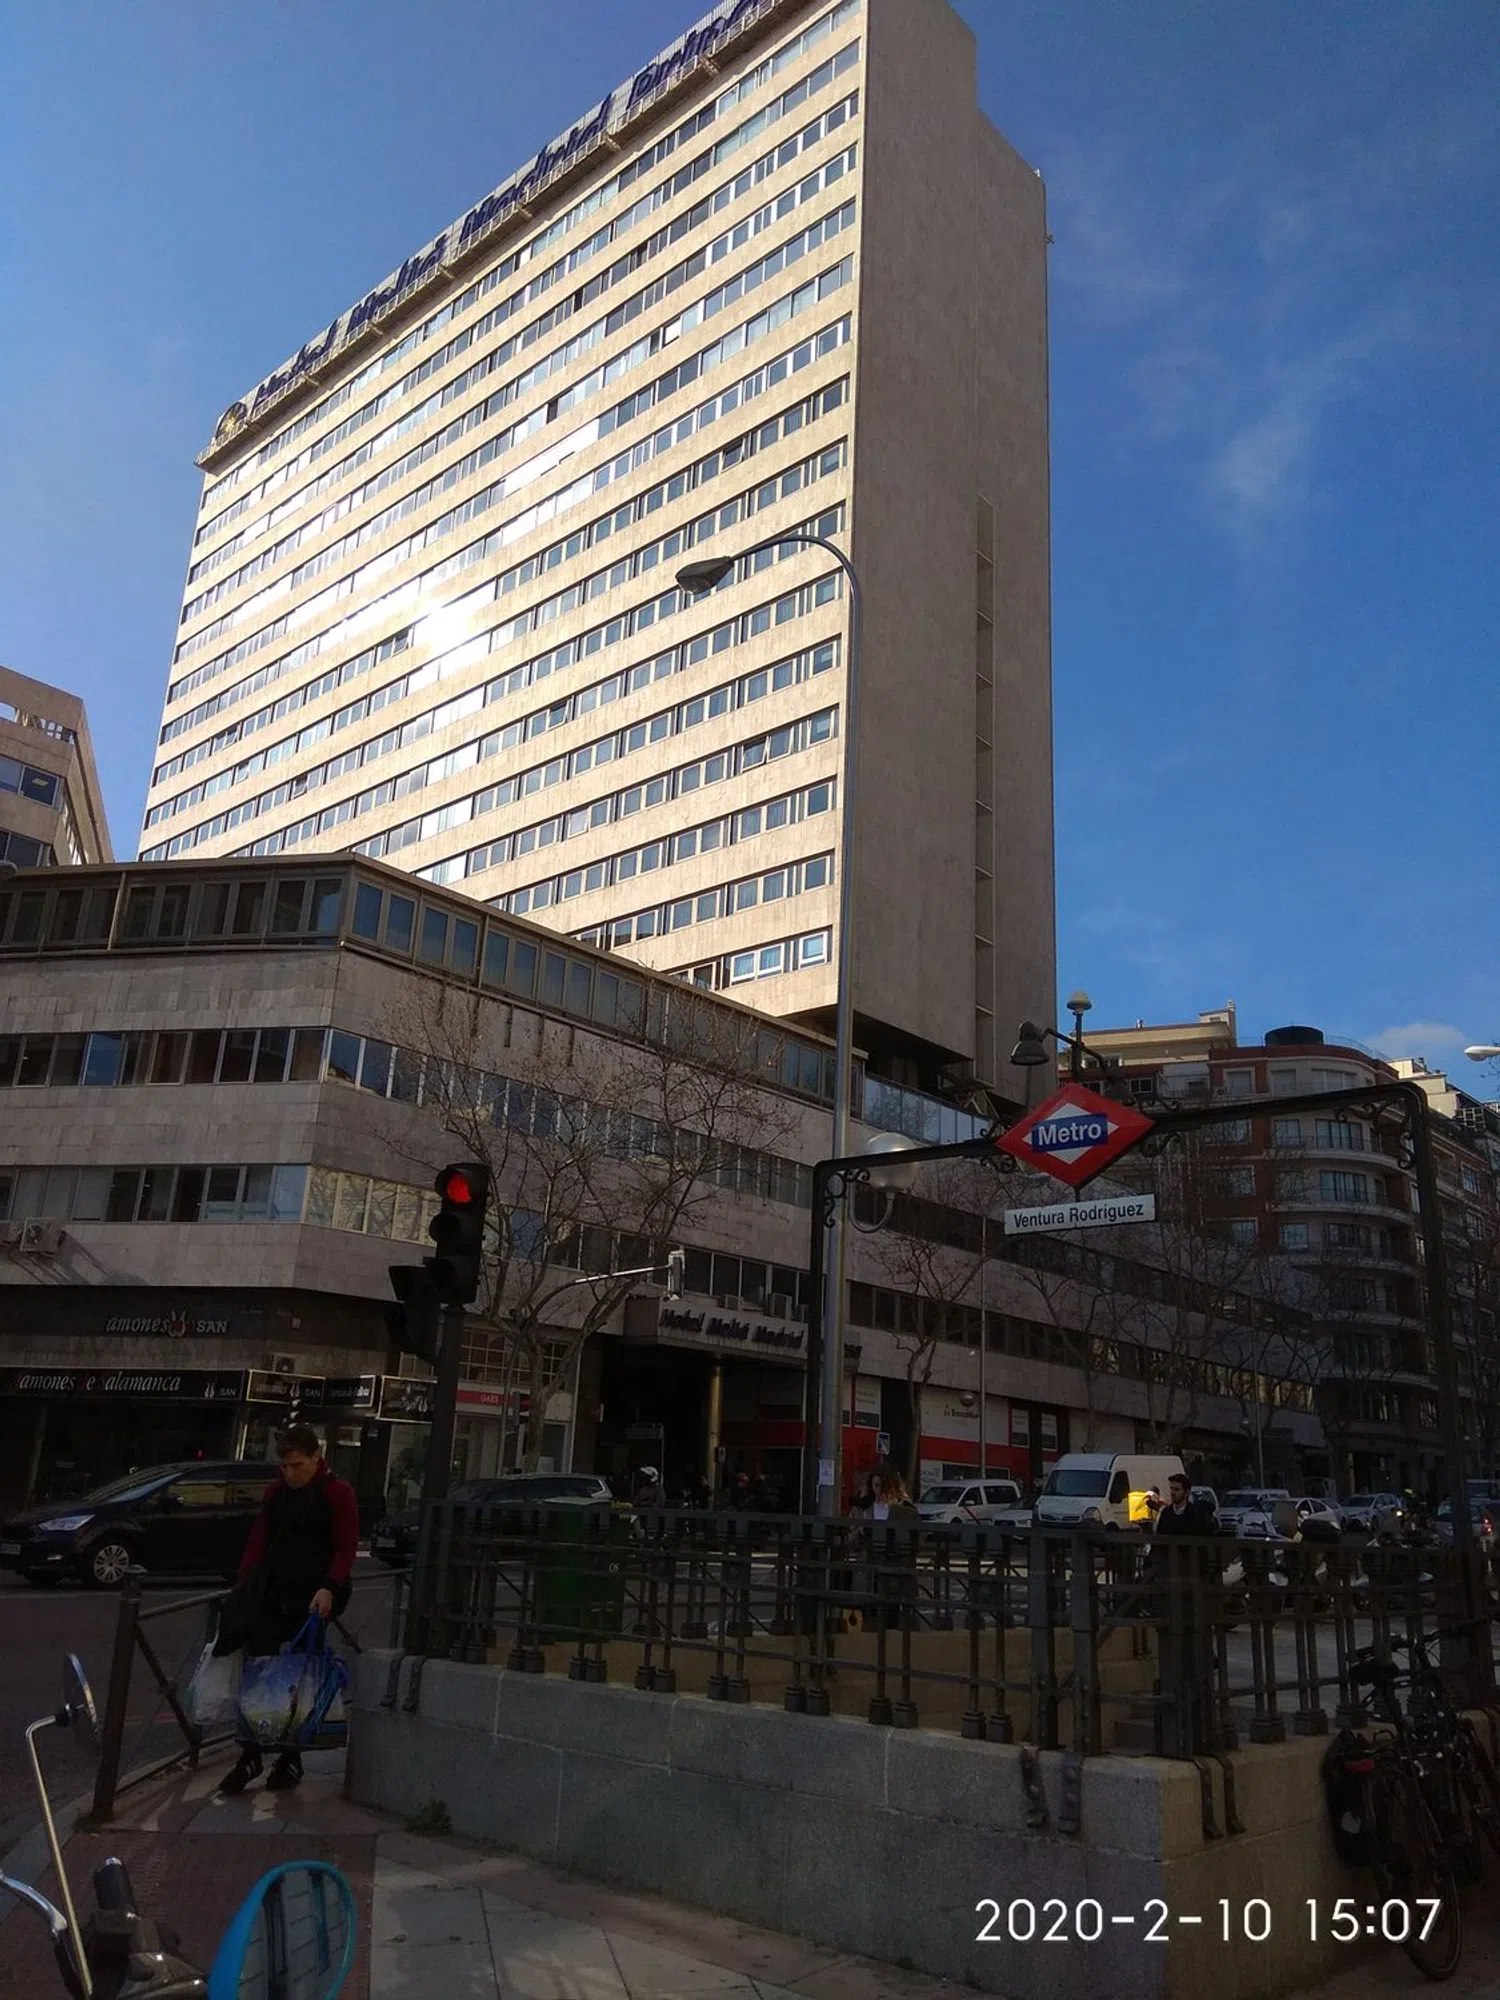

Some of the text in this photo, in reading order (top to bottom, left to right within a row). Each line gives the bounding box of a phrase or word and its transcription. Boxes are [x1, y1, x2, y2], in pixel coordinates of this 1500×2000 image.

[1038, 1121, 1102, 1147] Metro
[1013, 1202, 1144, 1229] Ventura Rodríguez
[195, 1319, 228, 1334] SAN
[752, 1324, 804, 1349] Madrid
[18, 1374, 77, 1392] amones
[103, 1370, 182, 1392] alamanca
